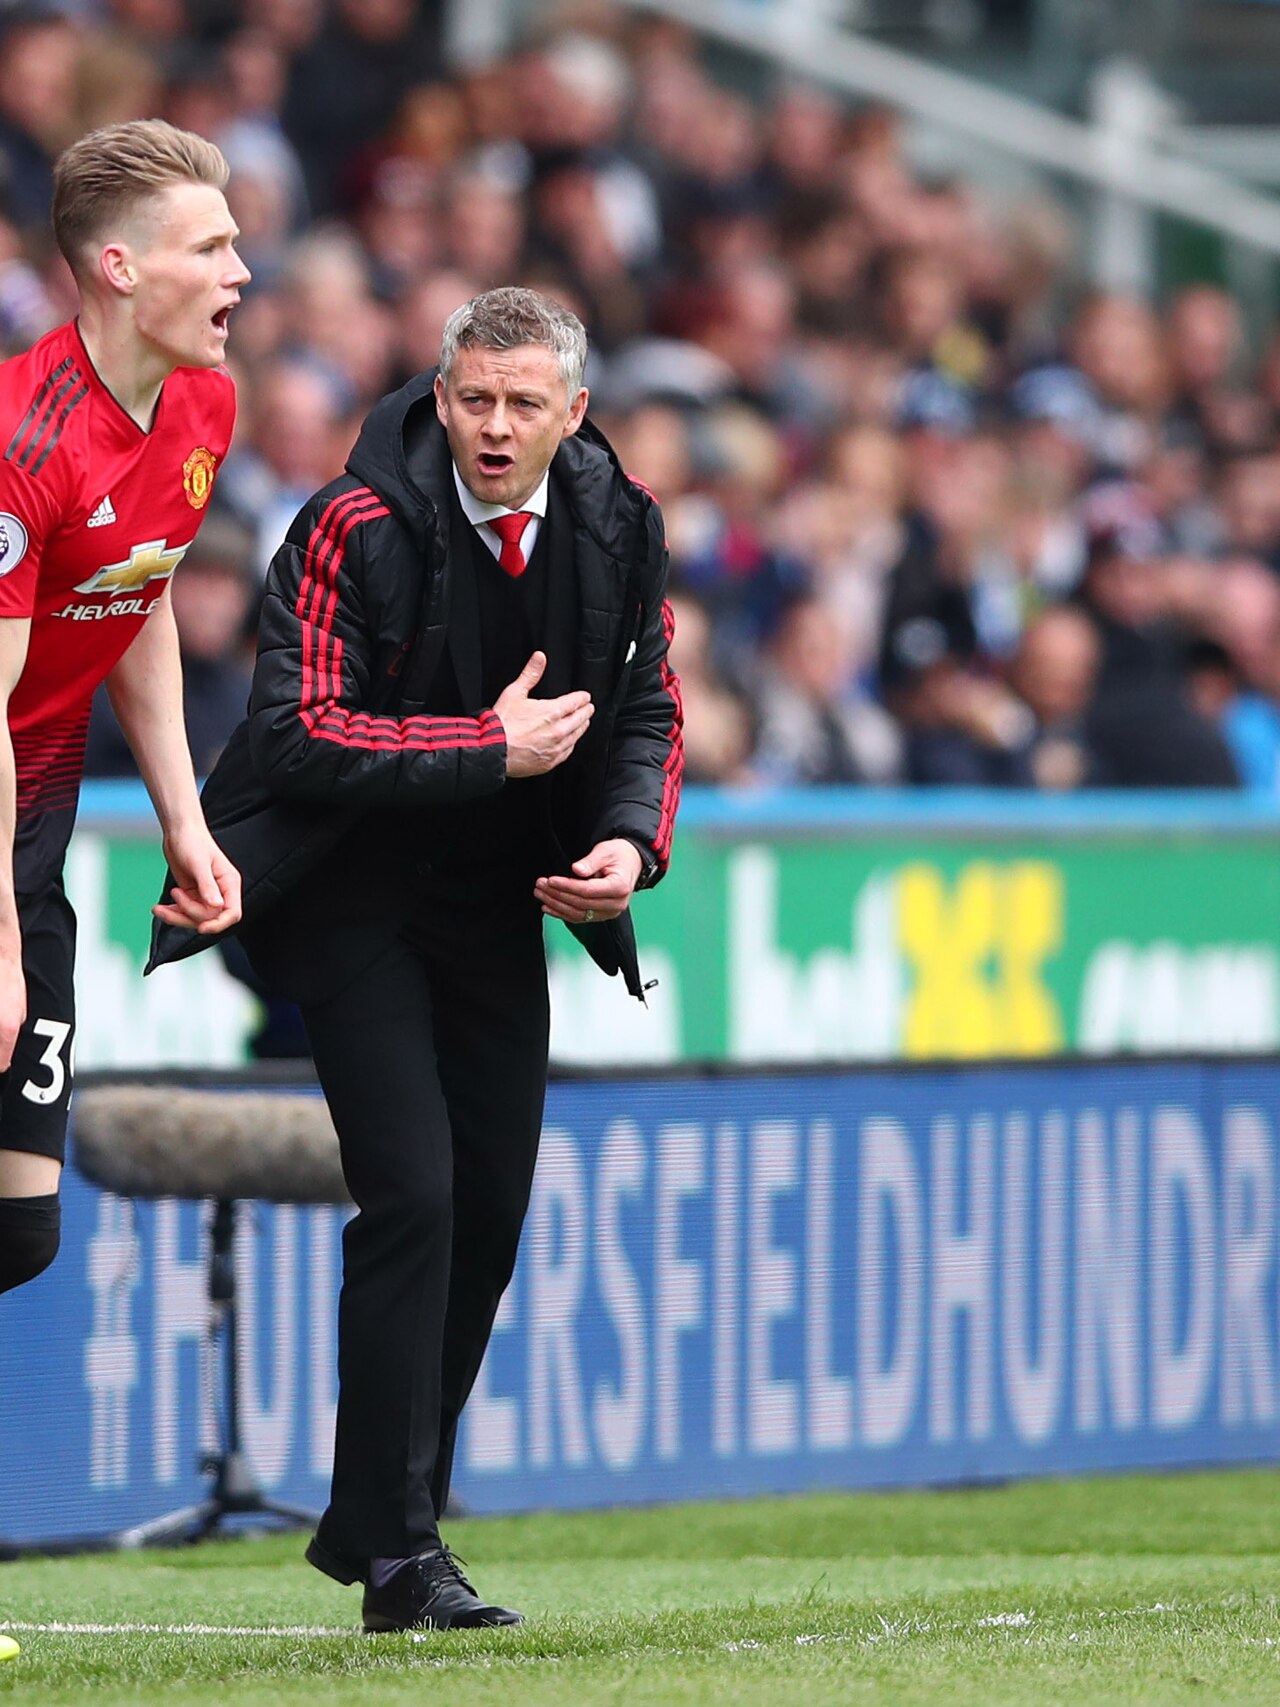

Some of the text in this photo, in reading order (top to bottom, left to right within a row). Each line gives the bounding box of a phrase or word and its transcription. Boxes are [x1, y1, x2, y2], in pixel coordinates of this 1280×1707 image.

[86, 513, 116, 528] adidas
[21, 1018, 75, 1111] 3
[84, 1104, 1276, 1488] #HUERSFIELDHUNDR
